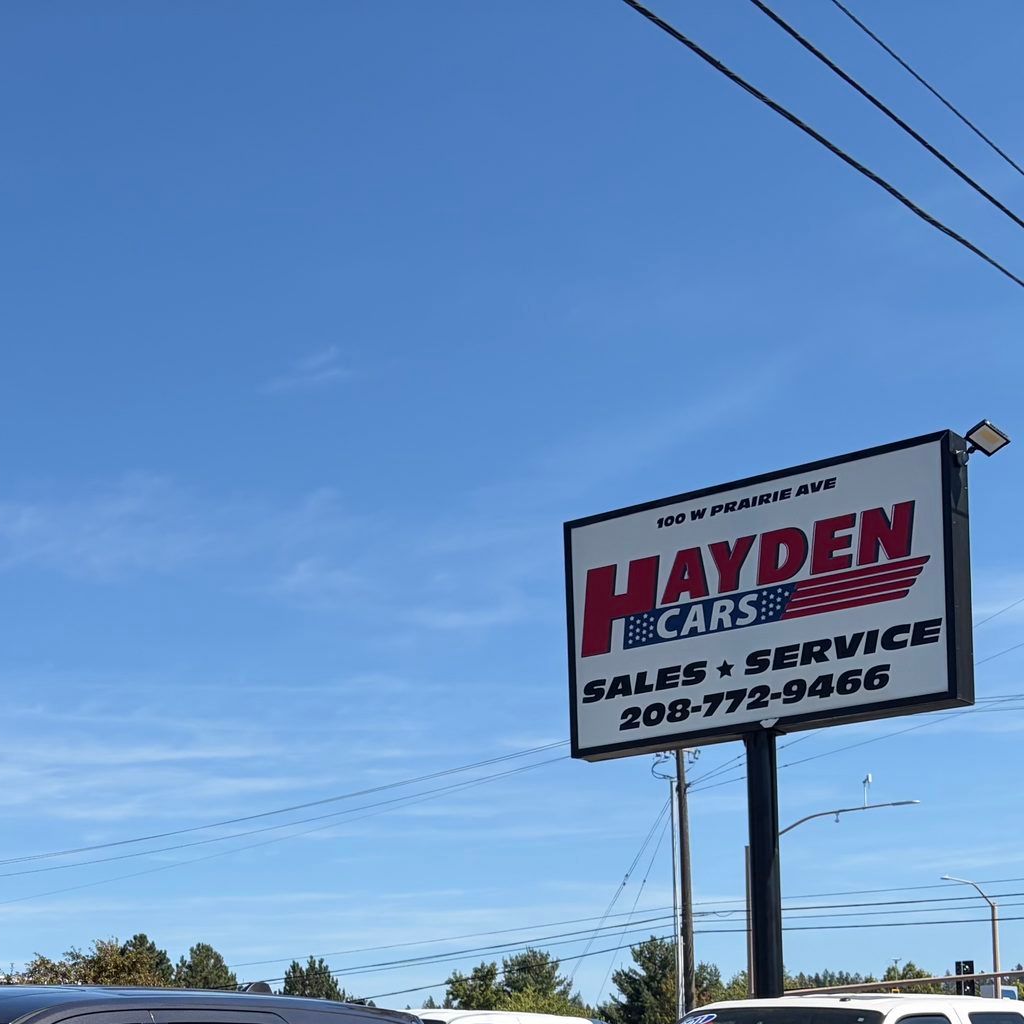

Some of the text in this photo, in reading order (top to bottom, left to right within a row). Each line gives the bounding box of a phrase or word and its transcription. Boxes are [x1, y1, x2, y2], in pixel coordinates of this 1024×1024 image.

[656, 477, 837, 529] 100 W PRAIRIE AVE
[581, 500, 916, 658] HAYDEN
[656, 593, 758, 639] CARS
[582, 617, 943, 704] SALES SERVICE
[619, 663, 891, 731] 208-772-9466
